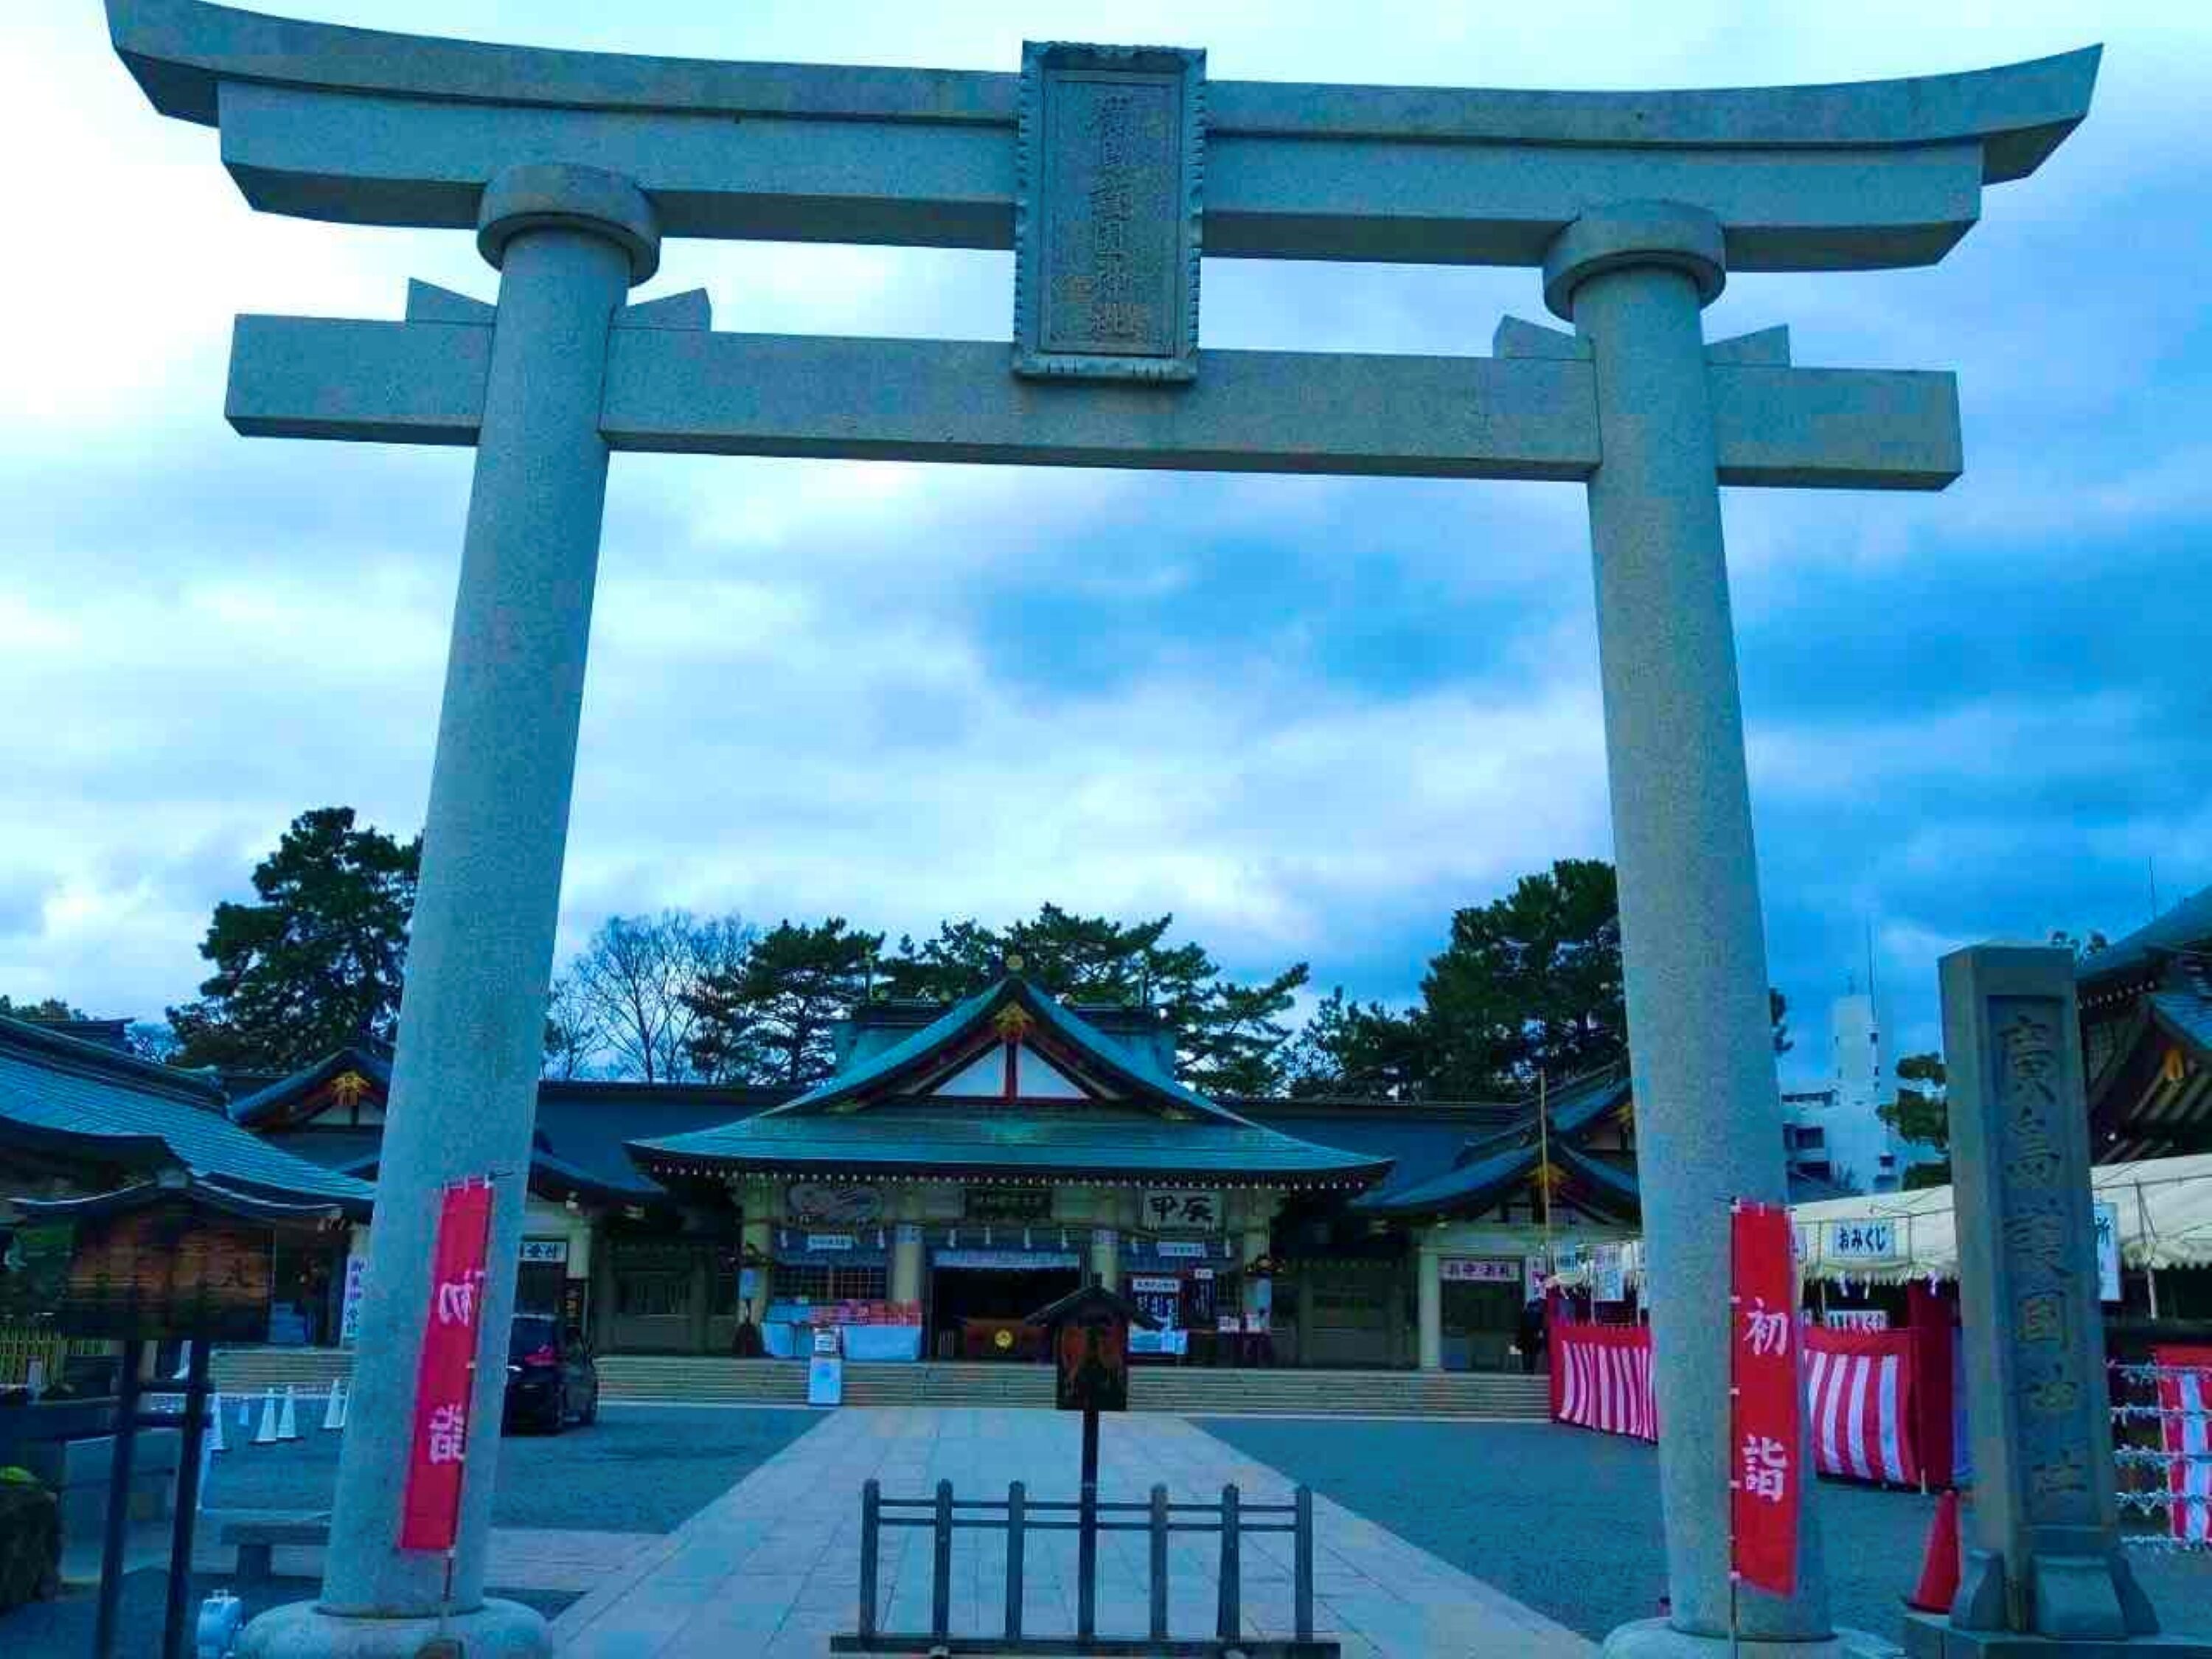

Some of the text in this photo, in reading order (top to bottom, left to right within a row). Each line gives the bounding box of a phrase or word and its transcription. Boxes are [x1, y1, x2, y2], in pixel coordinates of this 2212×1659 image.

[1839, 1226, 1887, 1251] おみくじ
[1742, 1295, 1789, 1503] 初詣
